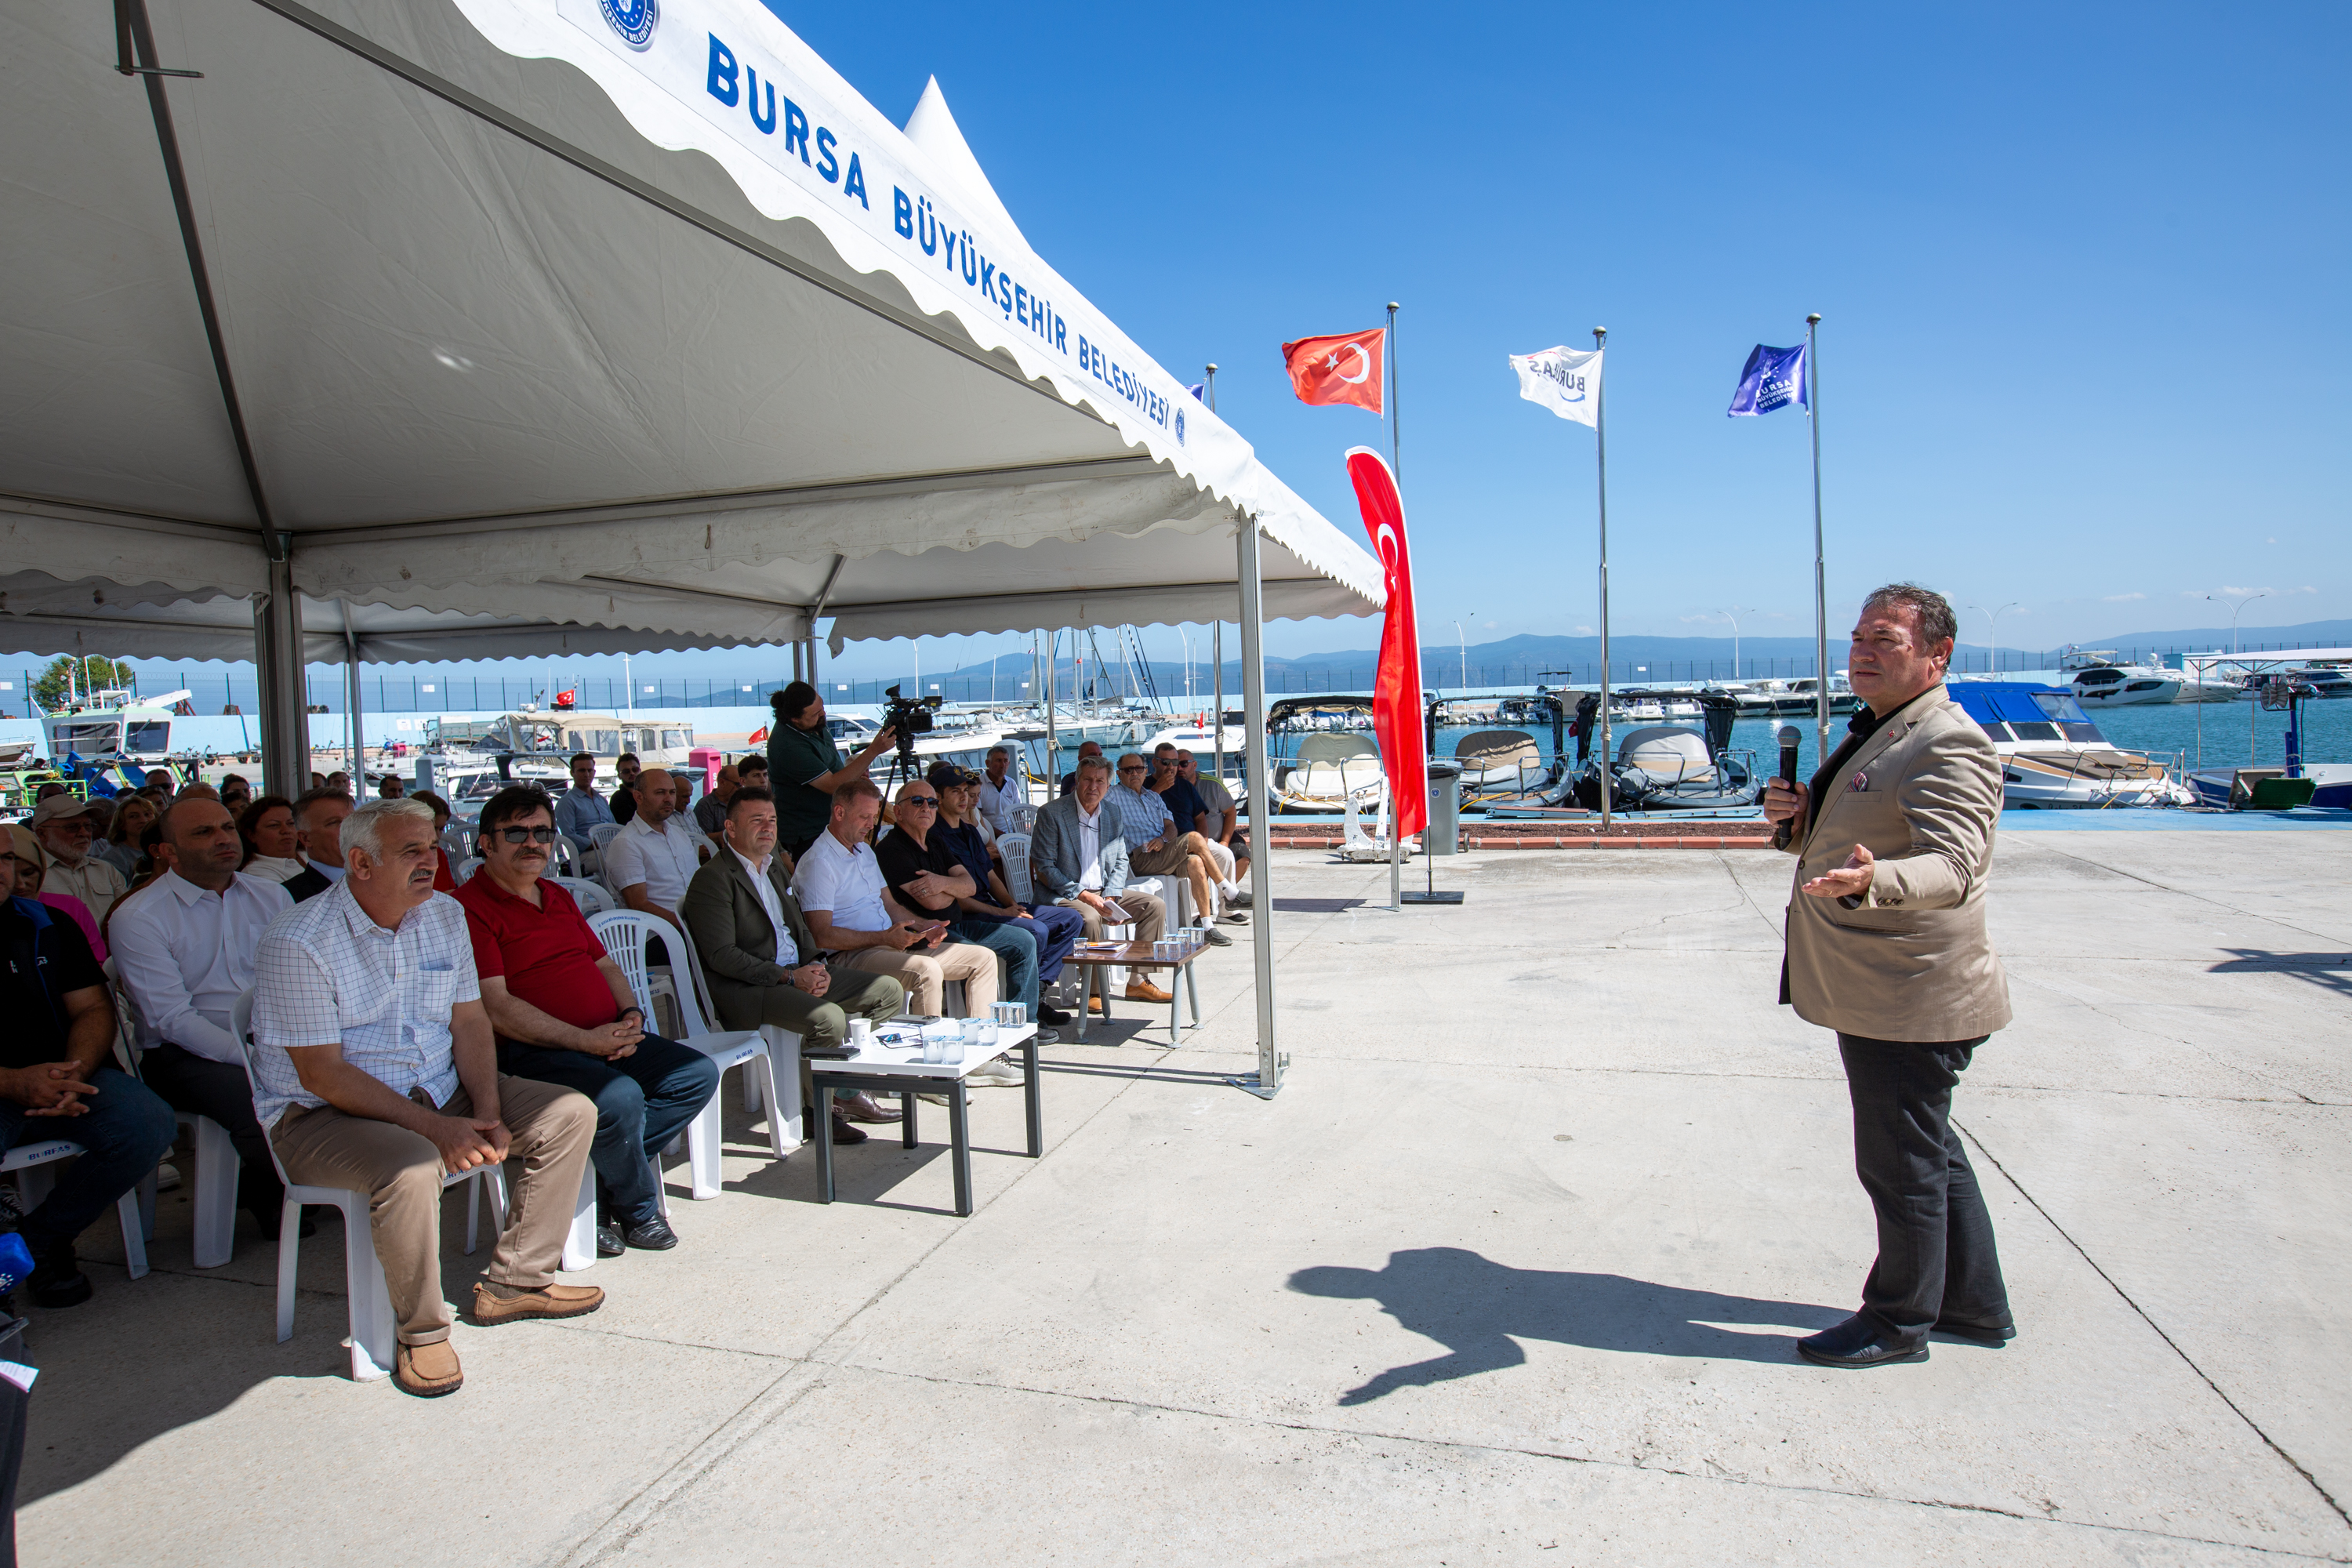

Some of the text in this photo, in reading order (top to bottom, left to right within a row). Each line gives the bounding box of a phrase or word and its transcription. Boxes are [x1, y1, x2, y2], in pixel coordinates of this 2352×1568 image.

[707, 31, 1169, 430] BURSA BÜYÜKŞEHİR BELEDİYESİ
